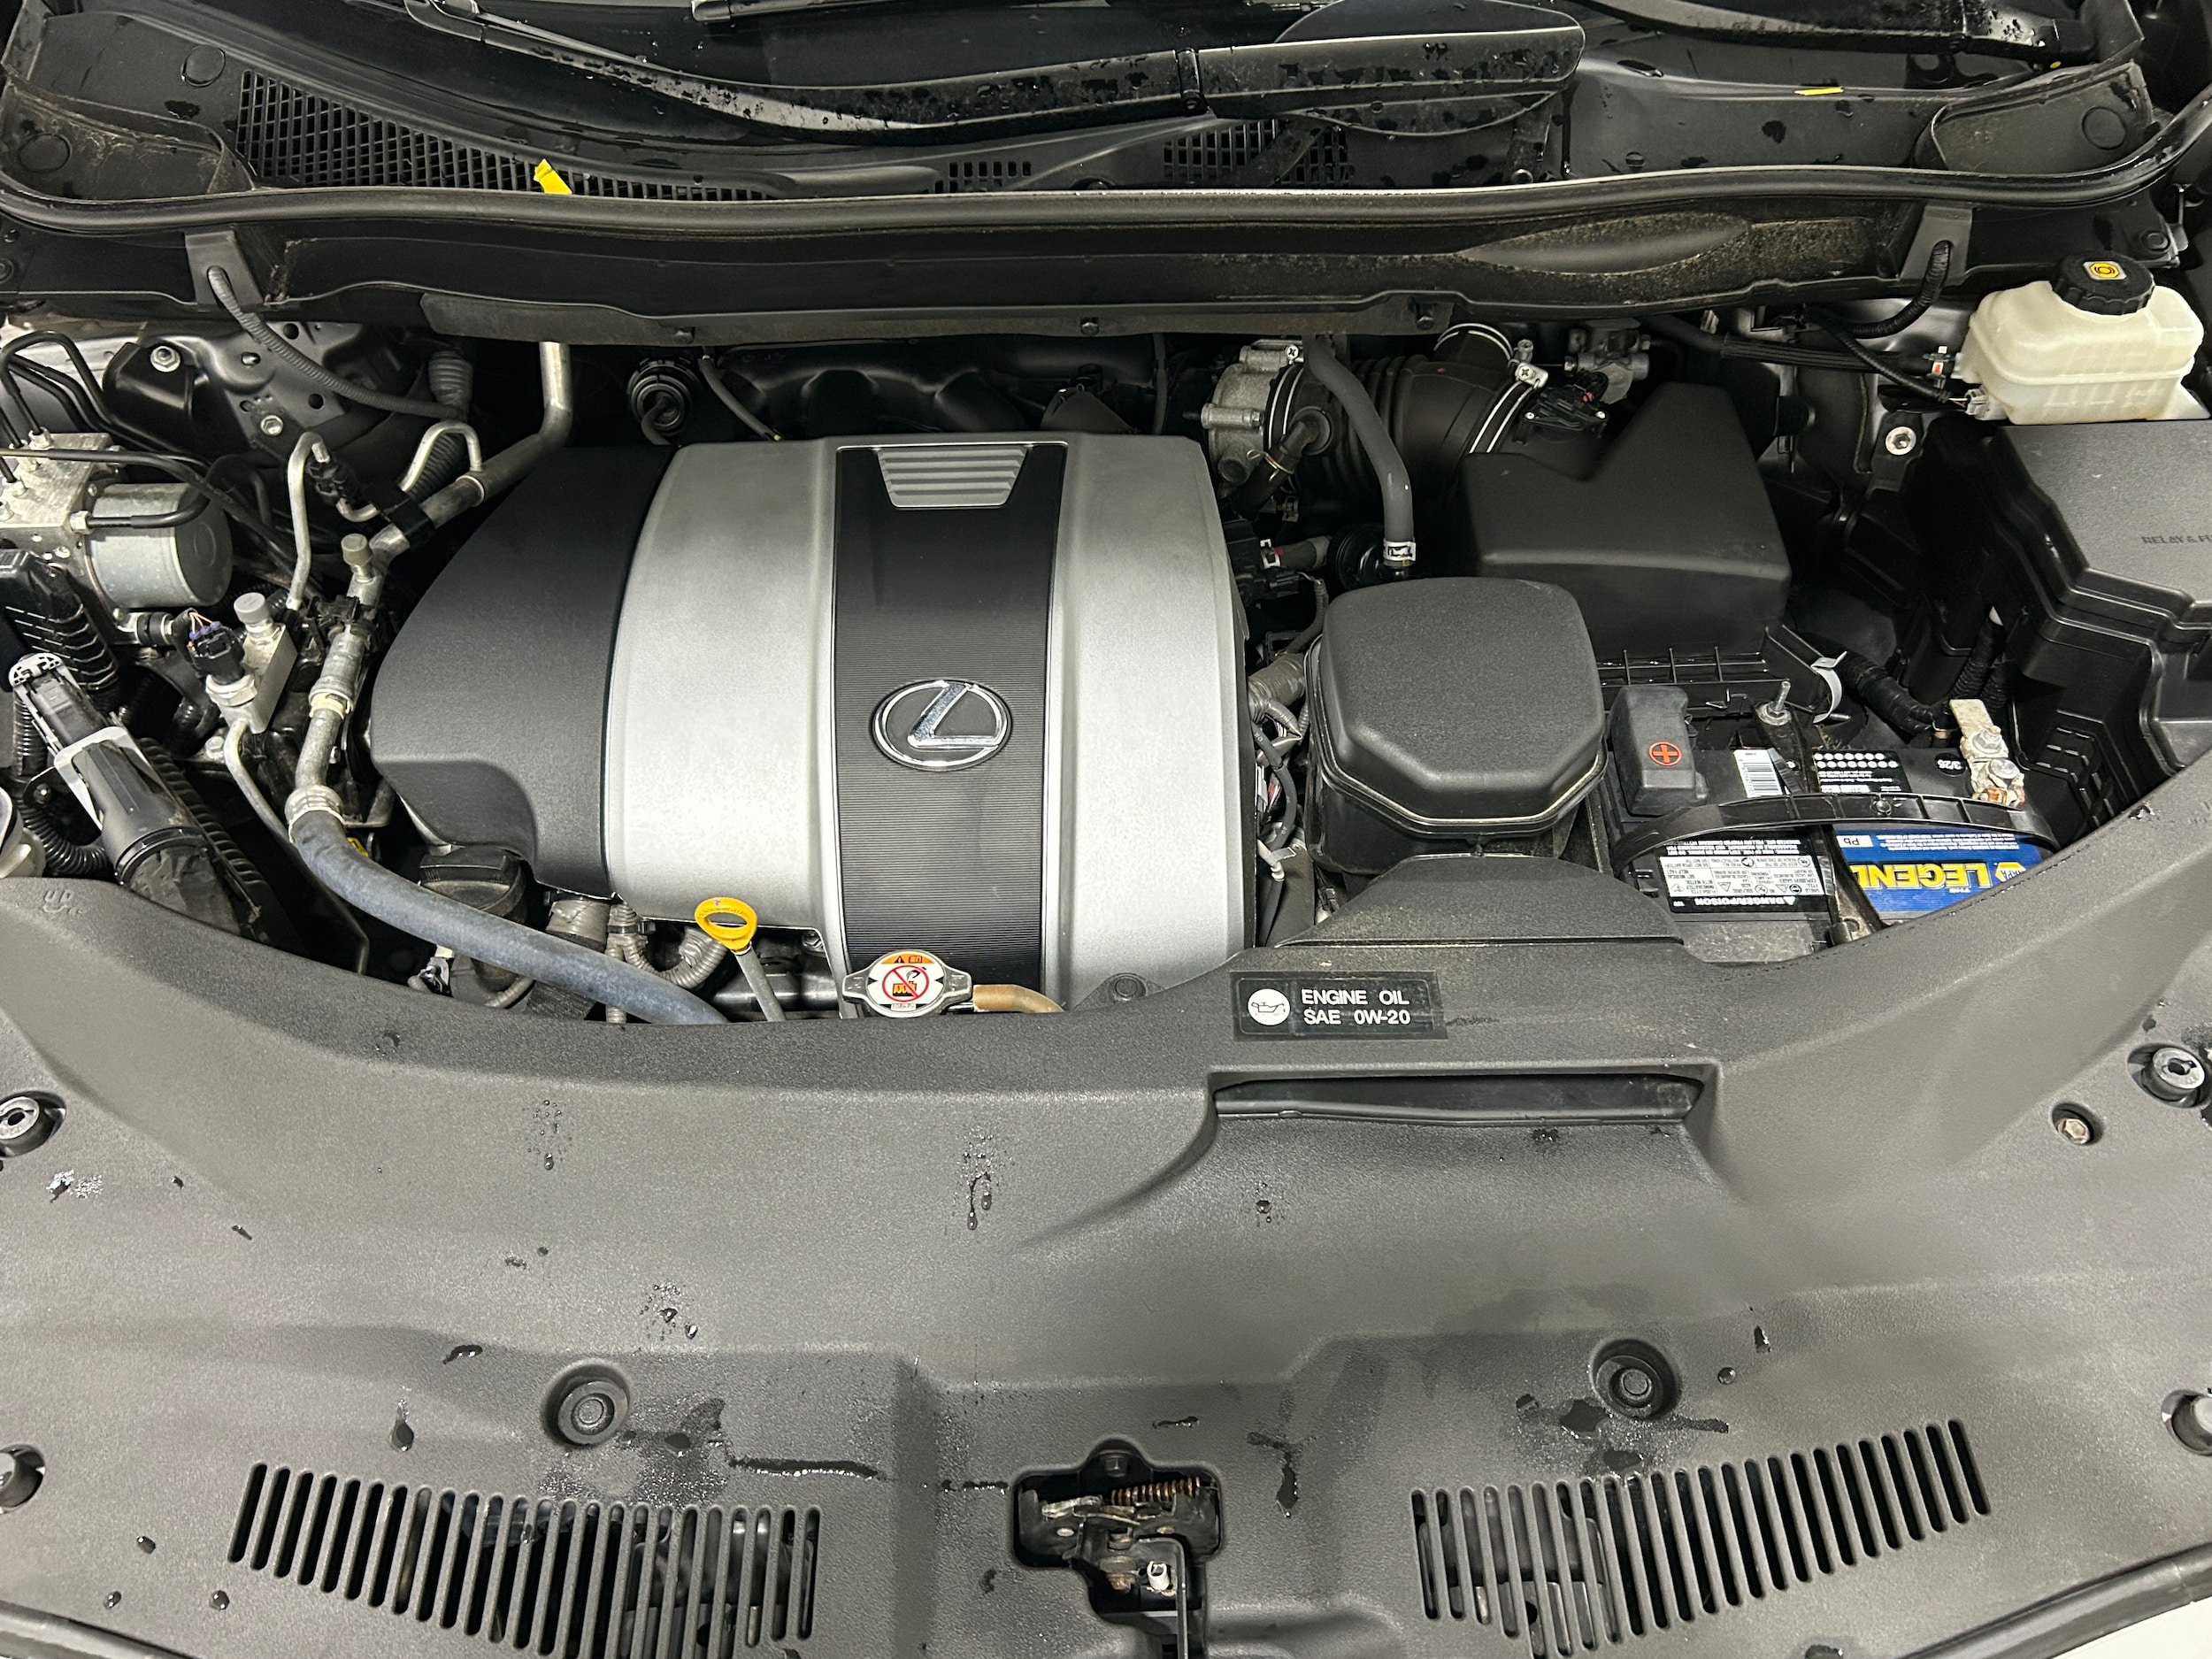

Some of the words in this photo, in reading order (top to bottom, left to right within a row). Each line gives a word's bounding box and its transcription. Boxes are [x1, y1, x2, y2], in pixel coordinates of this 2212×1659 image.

[1301, 988, 1368, 1005] ENGINE
[1379, 990, 1409, 1005] OIL
[1303, 1009, 1341, 1025] SAE
[1354, 1010, 1411, 1025] 0W-20
